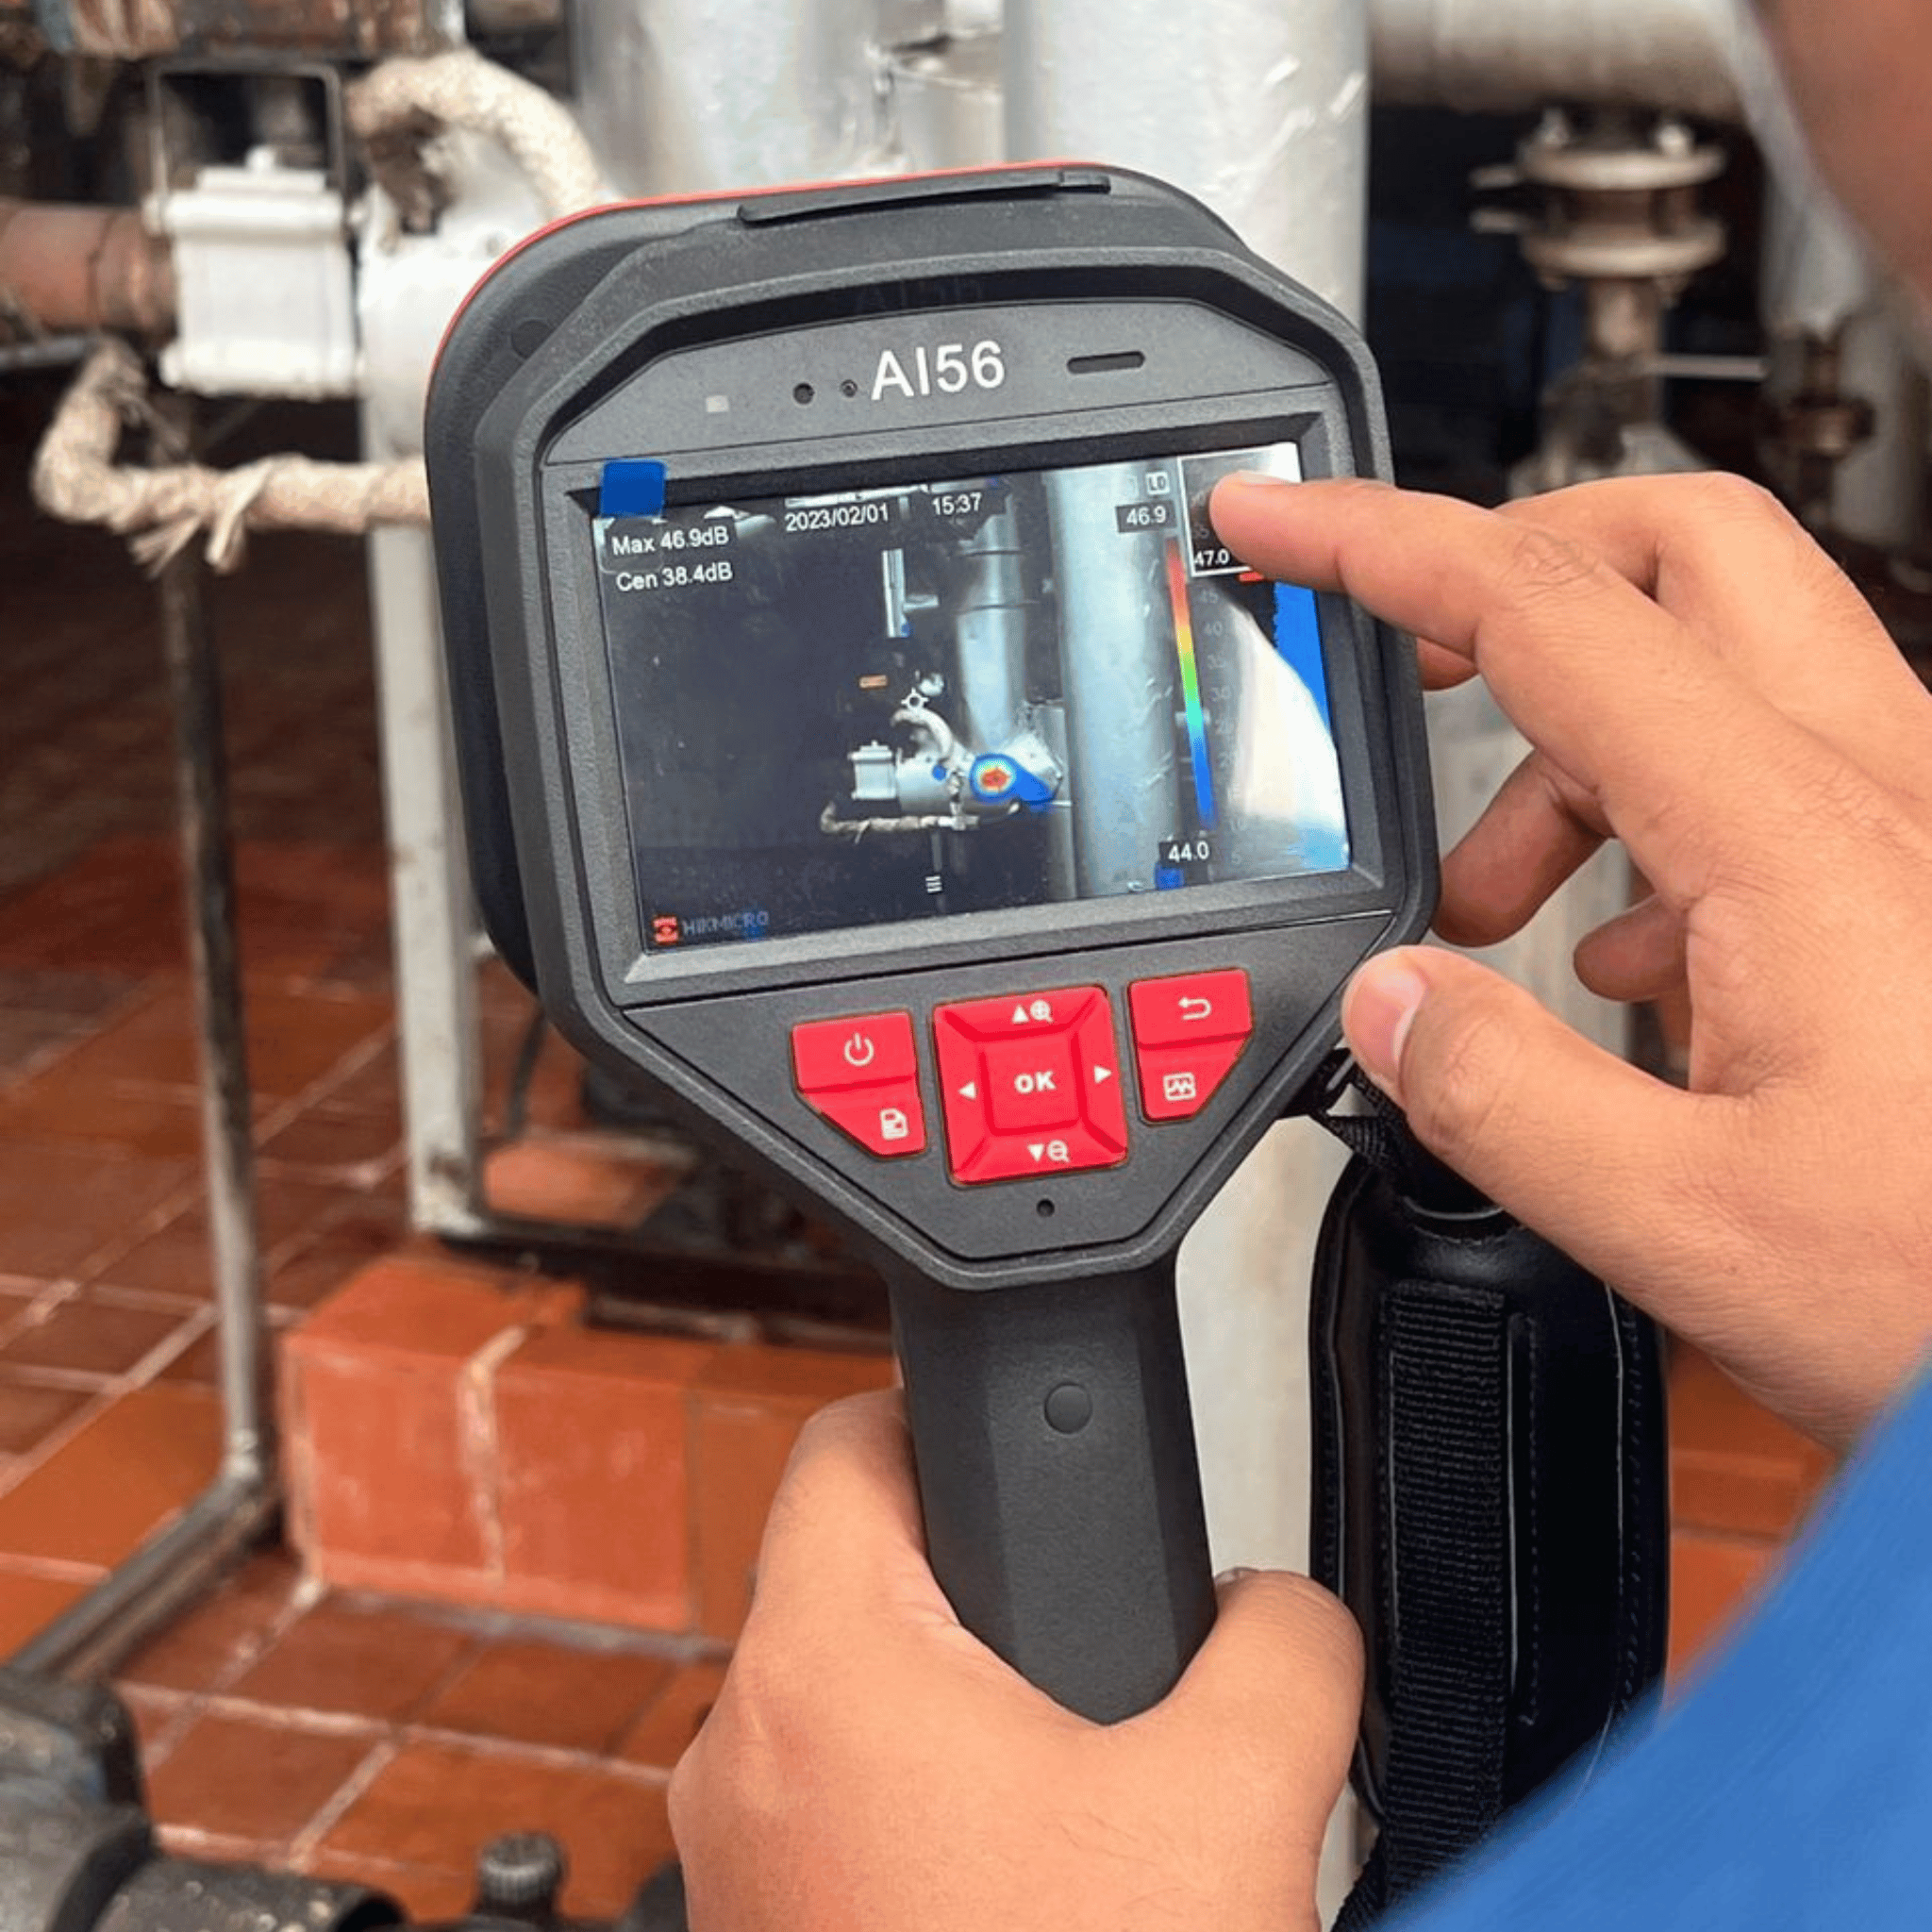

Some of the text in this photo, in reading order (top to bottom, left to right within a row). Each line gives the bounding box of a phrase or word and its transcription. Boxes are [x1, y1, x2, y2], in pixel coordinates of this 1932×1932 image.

[870, 340, 1007, 401] AI56
[784, 491, 983, 532] 2023/02/01 15:37
[1125, 505, 1167, 525] 46.9
[611, 526, 730, 556] Max 46.9dB
[1192, 547, 1230, 567] 47.0
[616, 562, 734, 592] Cen 38.4dB
[1167, 841, 1210, 863] 44.0
[1014, 1070, 1057, 1094] OK
